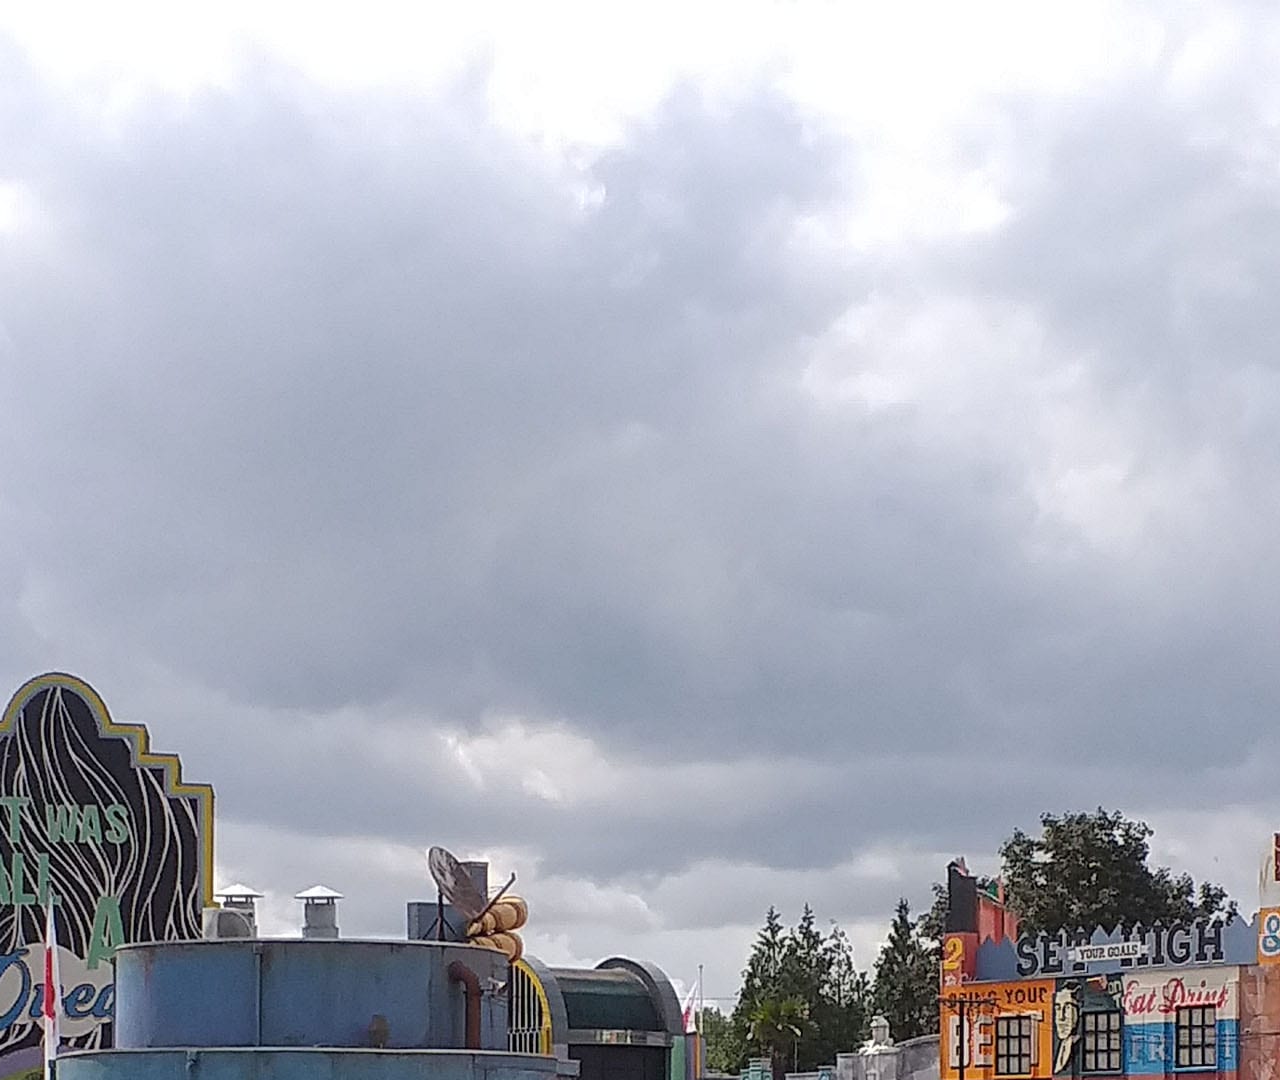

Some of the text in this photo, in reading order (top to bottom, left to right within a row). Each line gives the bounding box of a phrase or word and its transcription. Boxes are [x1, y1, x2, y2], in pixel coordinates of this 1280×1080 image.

[46, 803, 130, 845] WAS
[86, 896, 126, 970] A
[942, 937, 964, 971] 2
[1079, 943, 1139, 960] YOUR GOALS
[1120, 920, 1225, 967] HIGH
[949, 1010, 1045, 1070] BET
